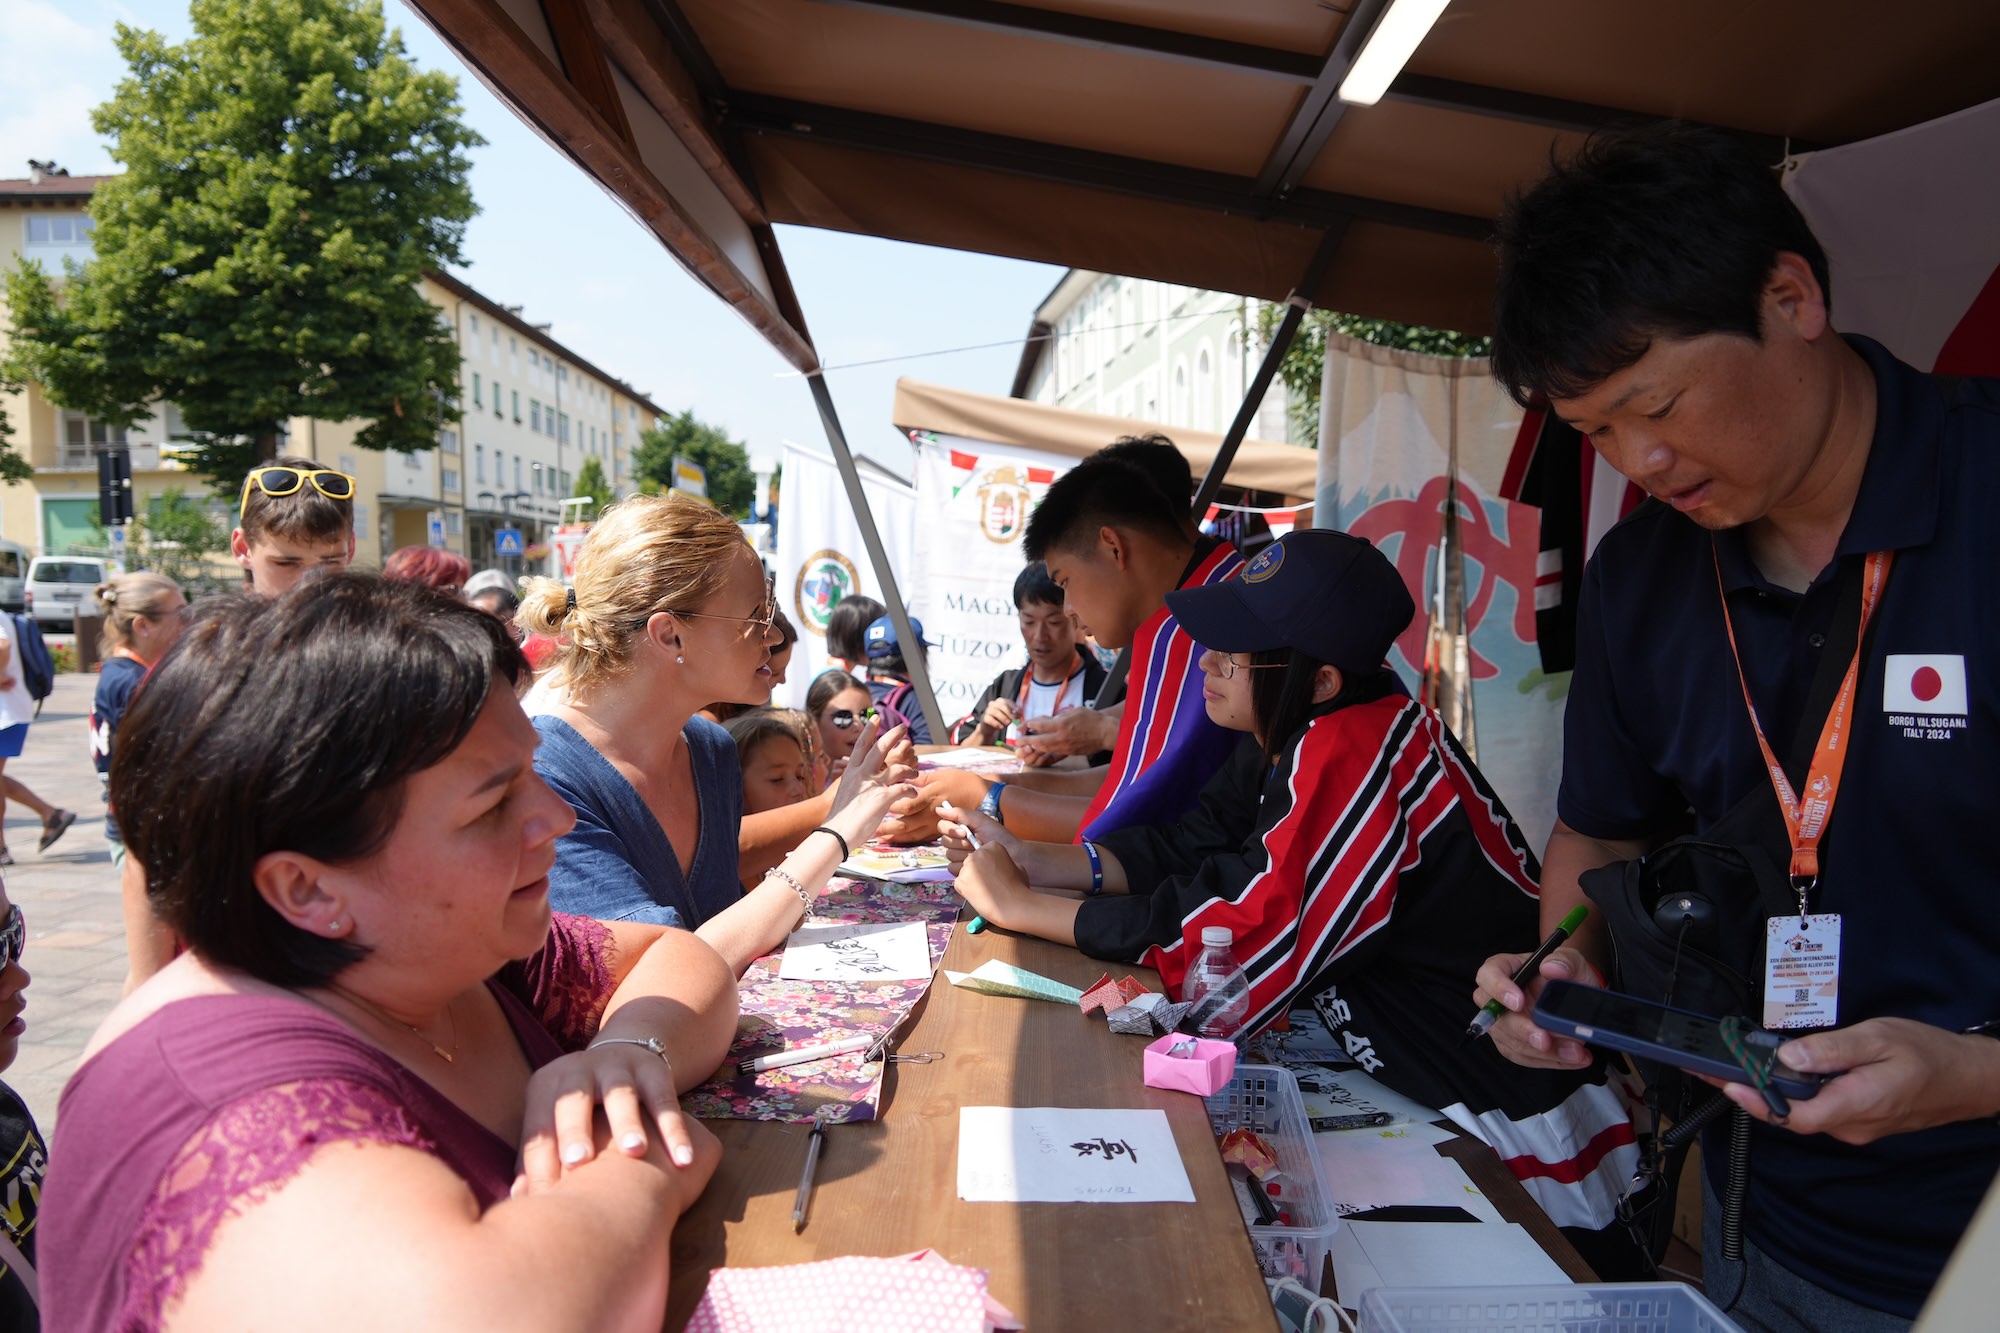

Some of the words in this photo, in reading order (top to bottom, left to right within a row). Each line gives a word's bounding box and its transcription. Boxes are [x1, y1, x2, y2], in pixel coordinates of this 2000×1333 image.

[944, 592, 1019, 616] MAGY
[1838, 691, 1848, 712] ALLIEVI
[1834, 716, 1842, 729] CTIF
[1888, 715, 1915, 727] BORGO
[1916, 717, 1967, 729] VALSUGANA
[1828, 732, 1839, 750] ITALIA
[1903, 727, 1925, 739] ITALY
[1926, 729, 1951, 740] 2024
[1806, 799, 1829, 838] TRENTINO
